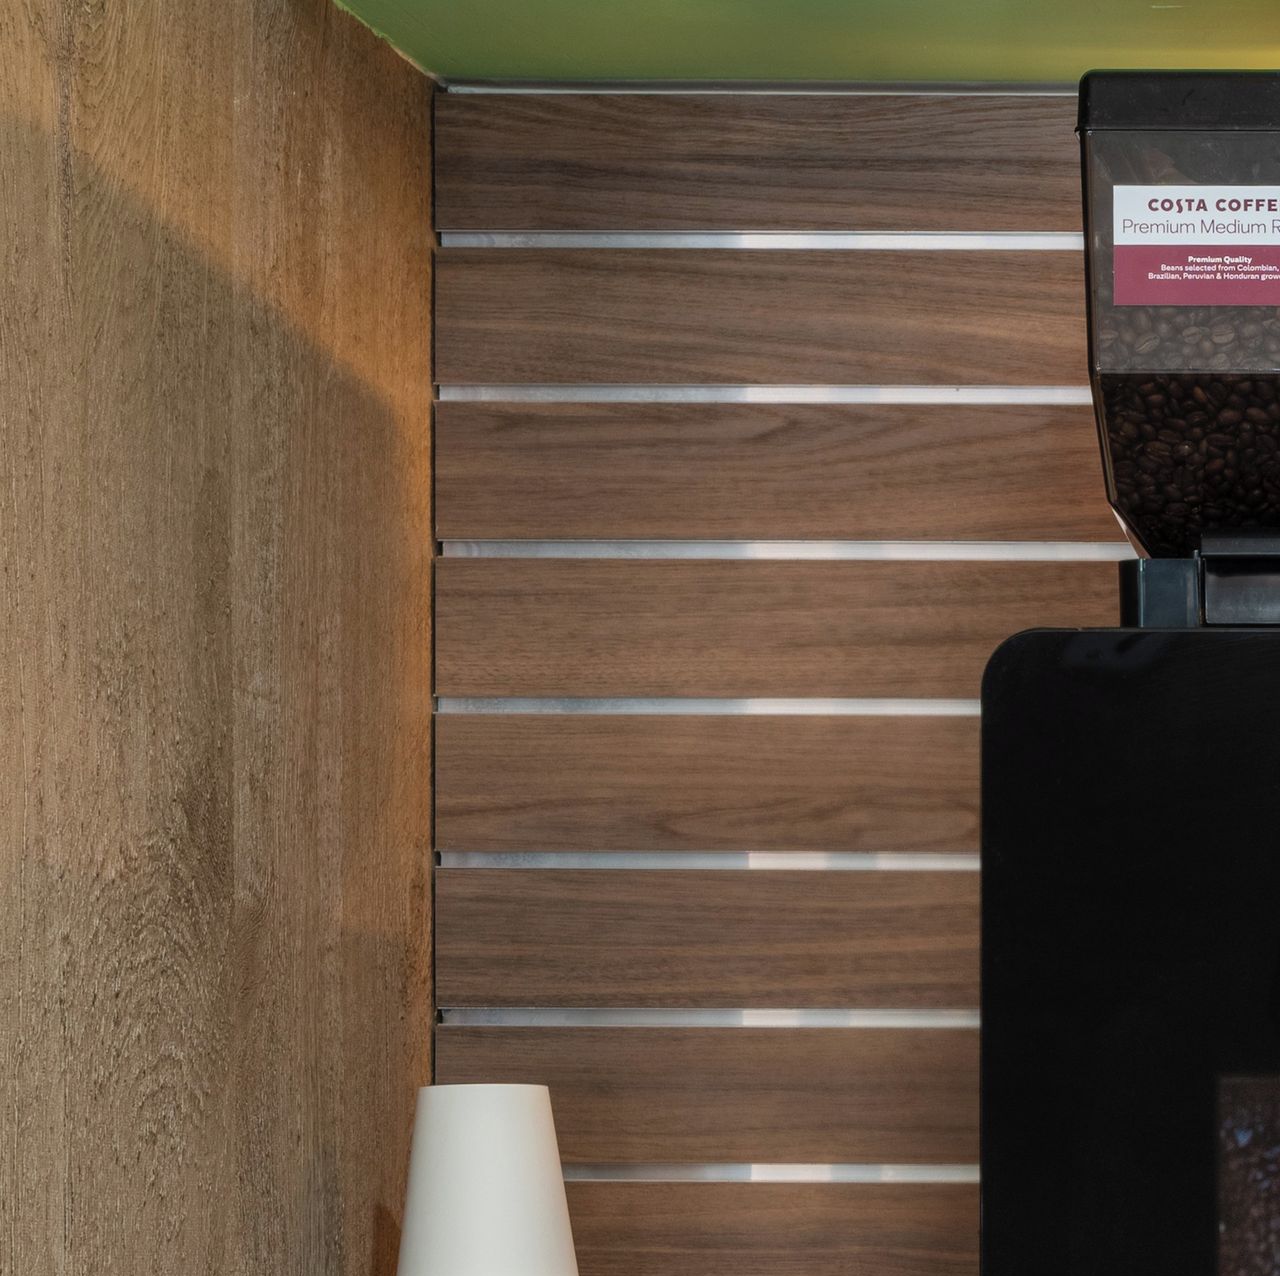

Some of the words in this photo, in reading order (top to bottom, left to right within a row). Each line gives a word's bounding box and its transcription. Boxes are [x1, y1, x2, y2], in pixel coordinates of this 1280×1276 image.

[1148, 199, 1208, 214] COSTA
[1123, 219, 1195, 234] Premium
[1201, 219, 1266, 234] Medium
[1224, 256, 1252, 264] Quality
[1237, 264, 1279, 272] Colombian,
